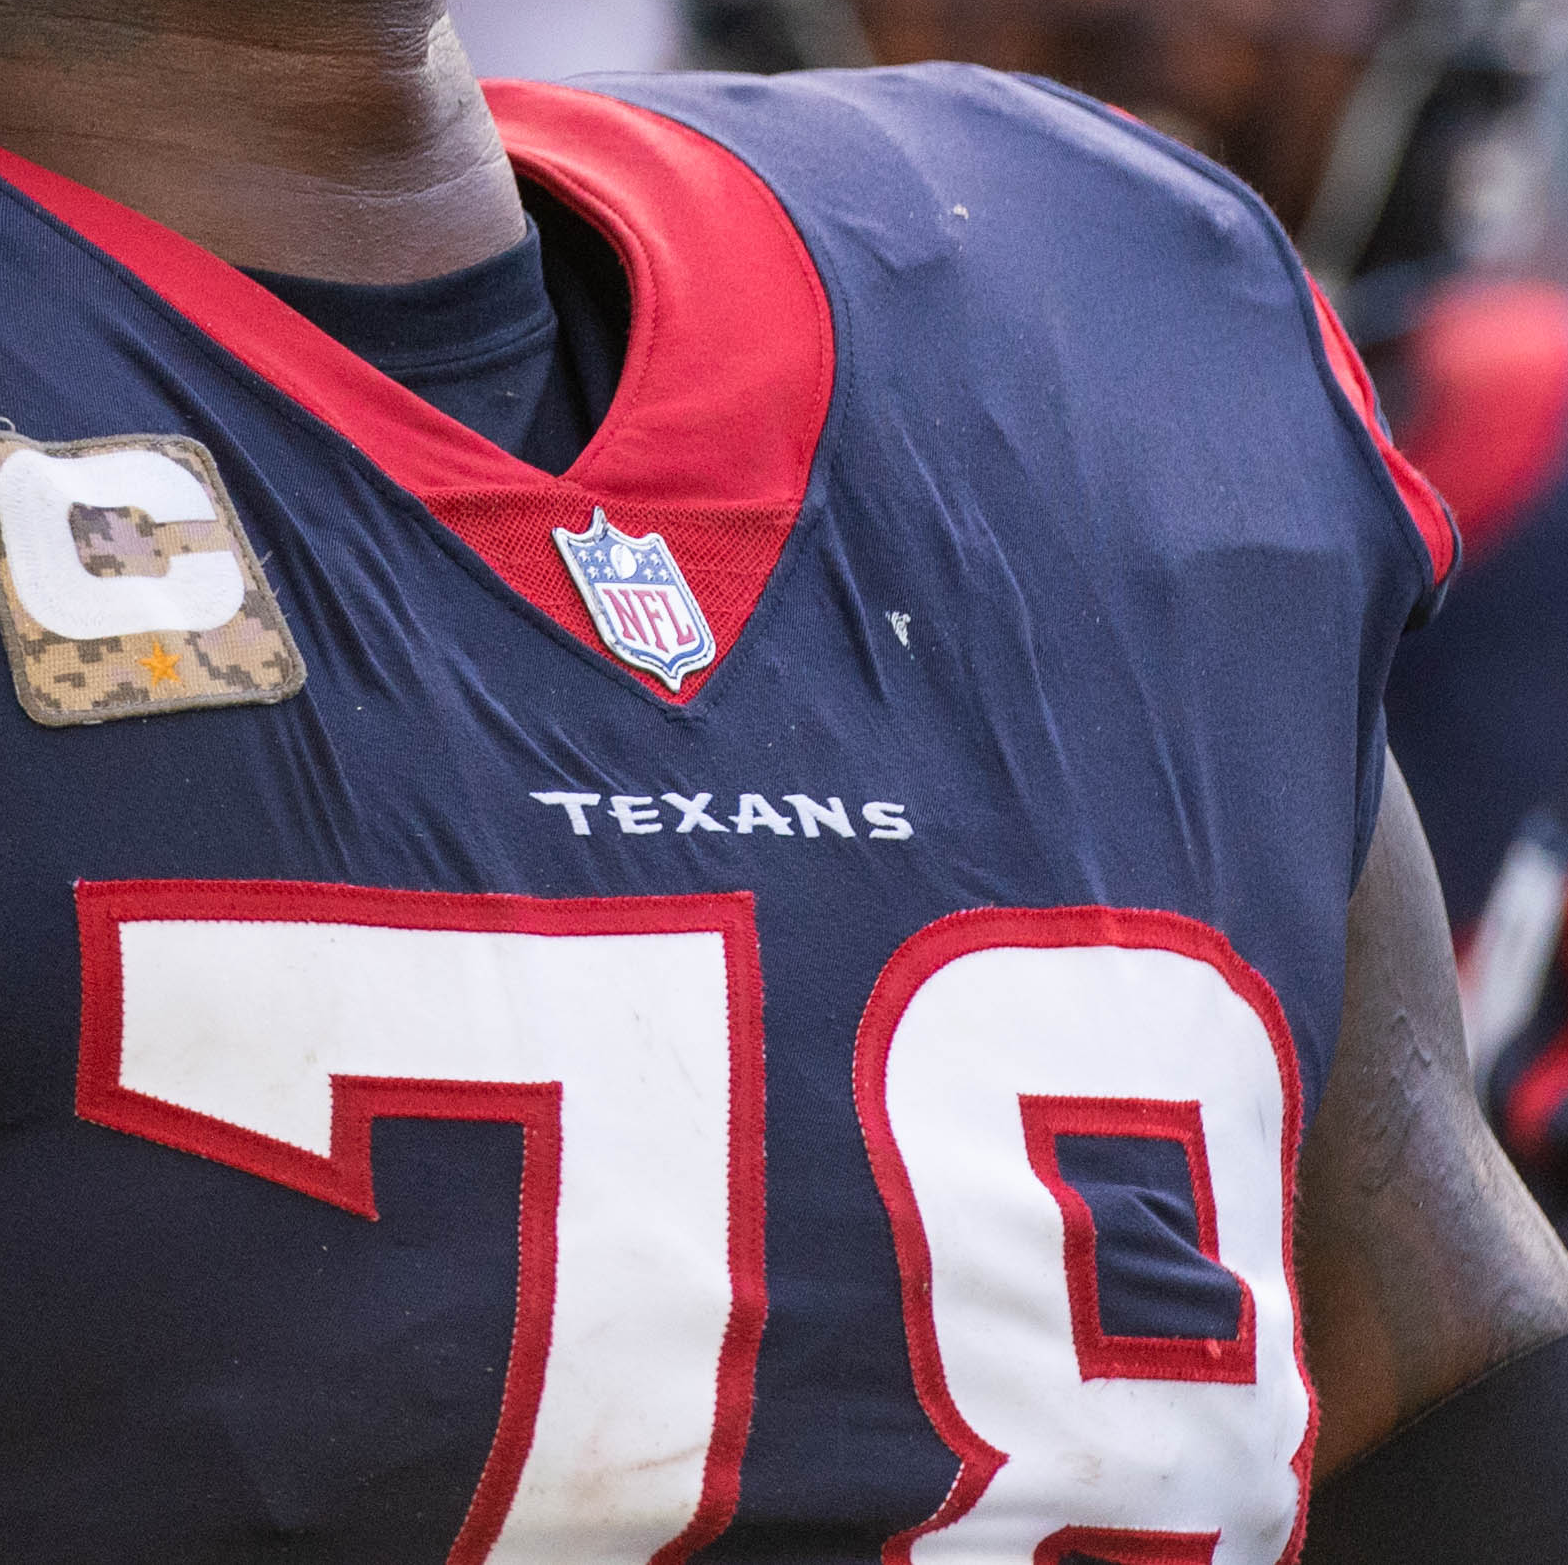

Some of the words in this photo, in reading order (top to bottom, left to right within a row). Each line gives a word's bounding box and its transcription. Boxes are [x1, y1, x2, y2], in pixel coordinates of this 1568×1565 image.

[602, 587, 697, 653] NFL
[528, 791, 915, 840] TEXANS
[74, 879, 1321, 1565] 78
